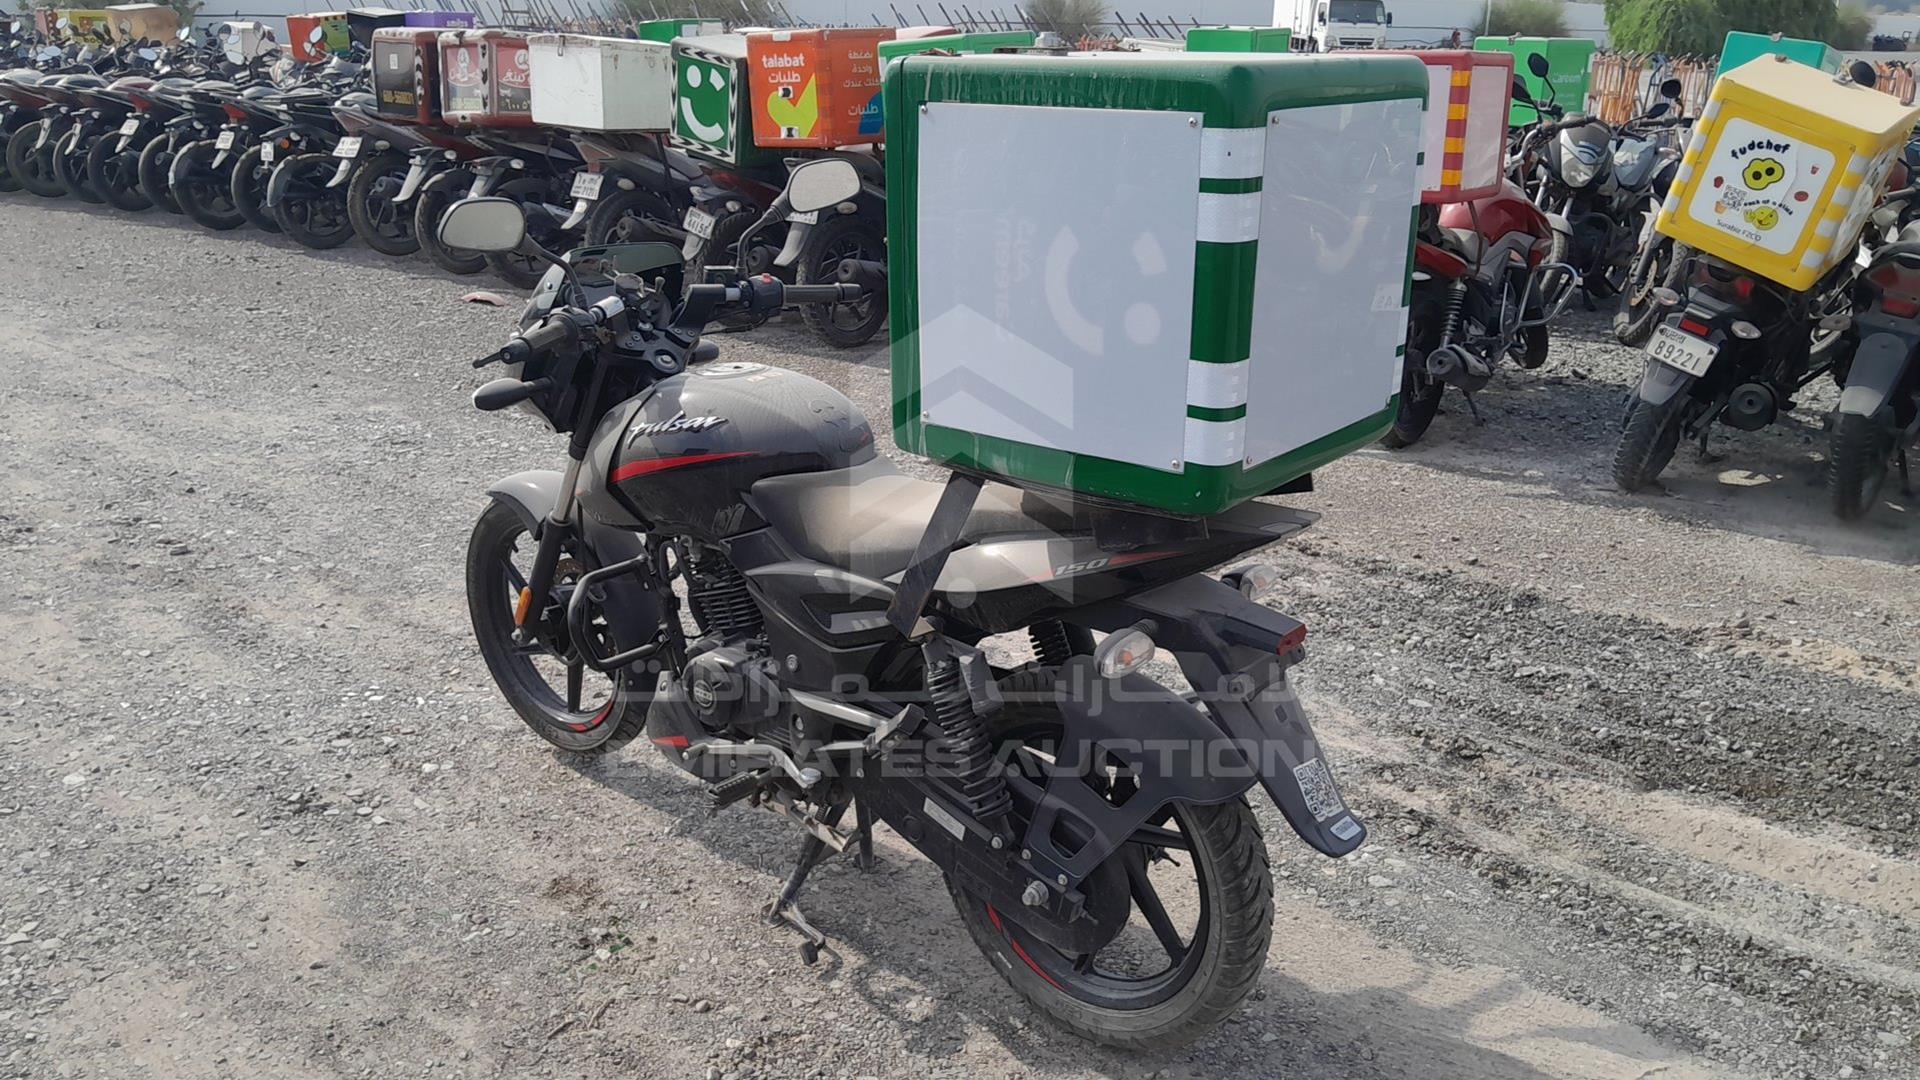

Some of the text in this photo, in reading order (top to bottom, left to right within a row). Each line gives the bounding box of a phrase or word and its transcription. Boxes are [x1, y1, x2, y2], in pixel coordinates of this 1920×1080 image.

[761, 52, 806, 69] talabat
[768, 71, 801, 85] طلبات
[1731, 139, 1791, 159] fudchef
[1654, 340, 1701, 371] 89221
[1055, 558, 1109, 577] 150
